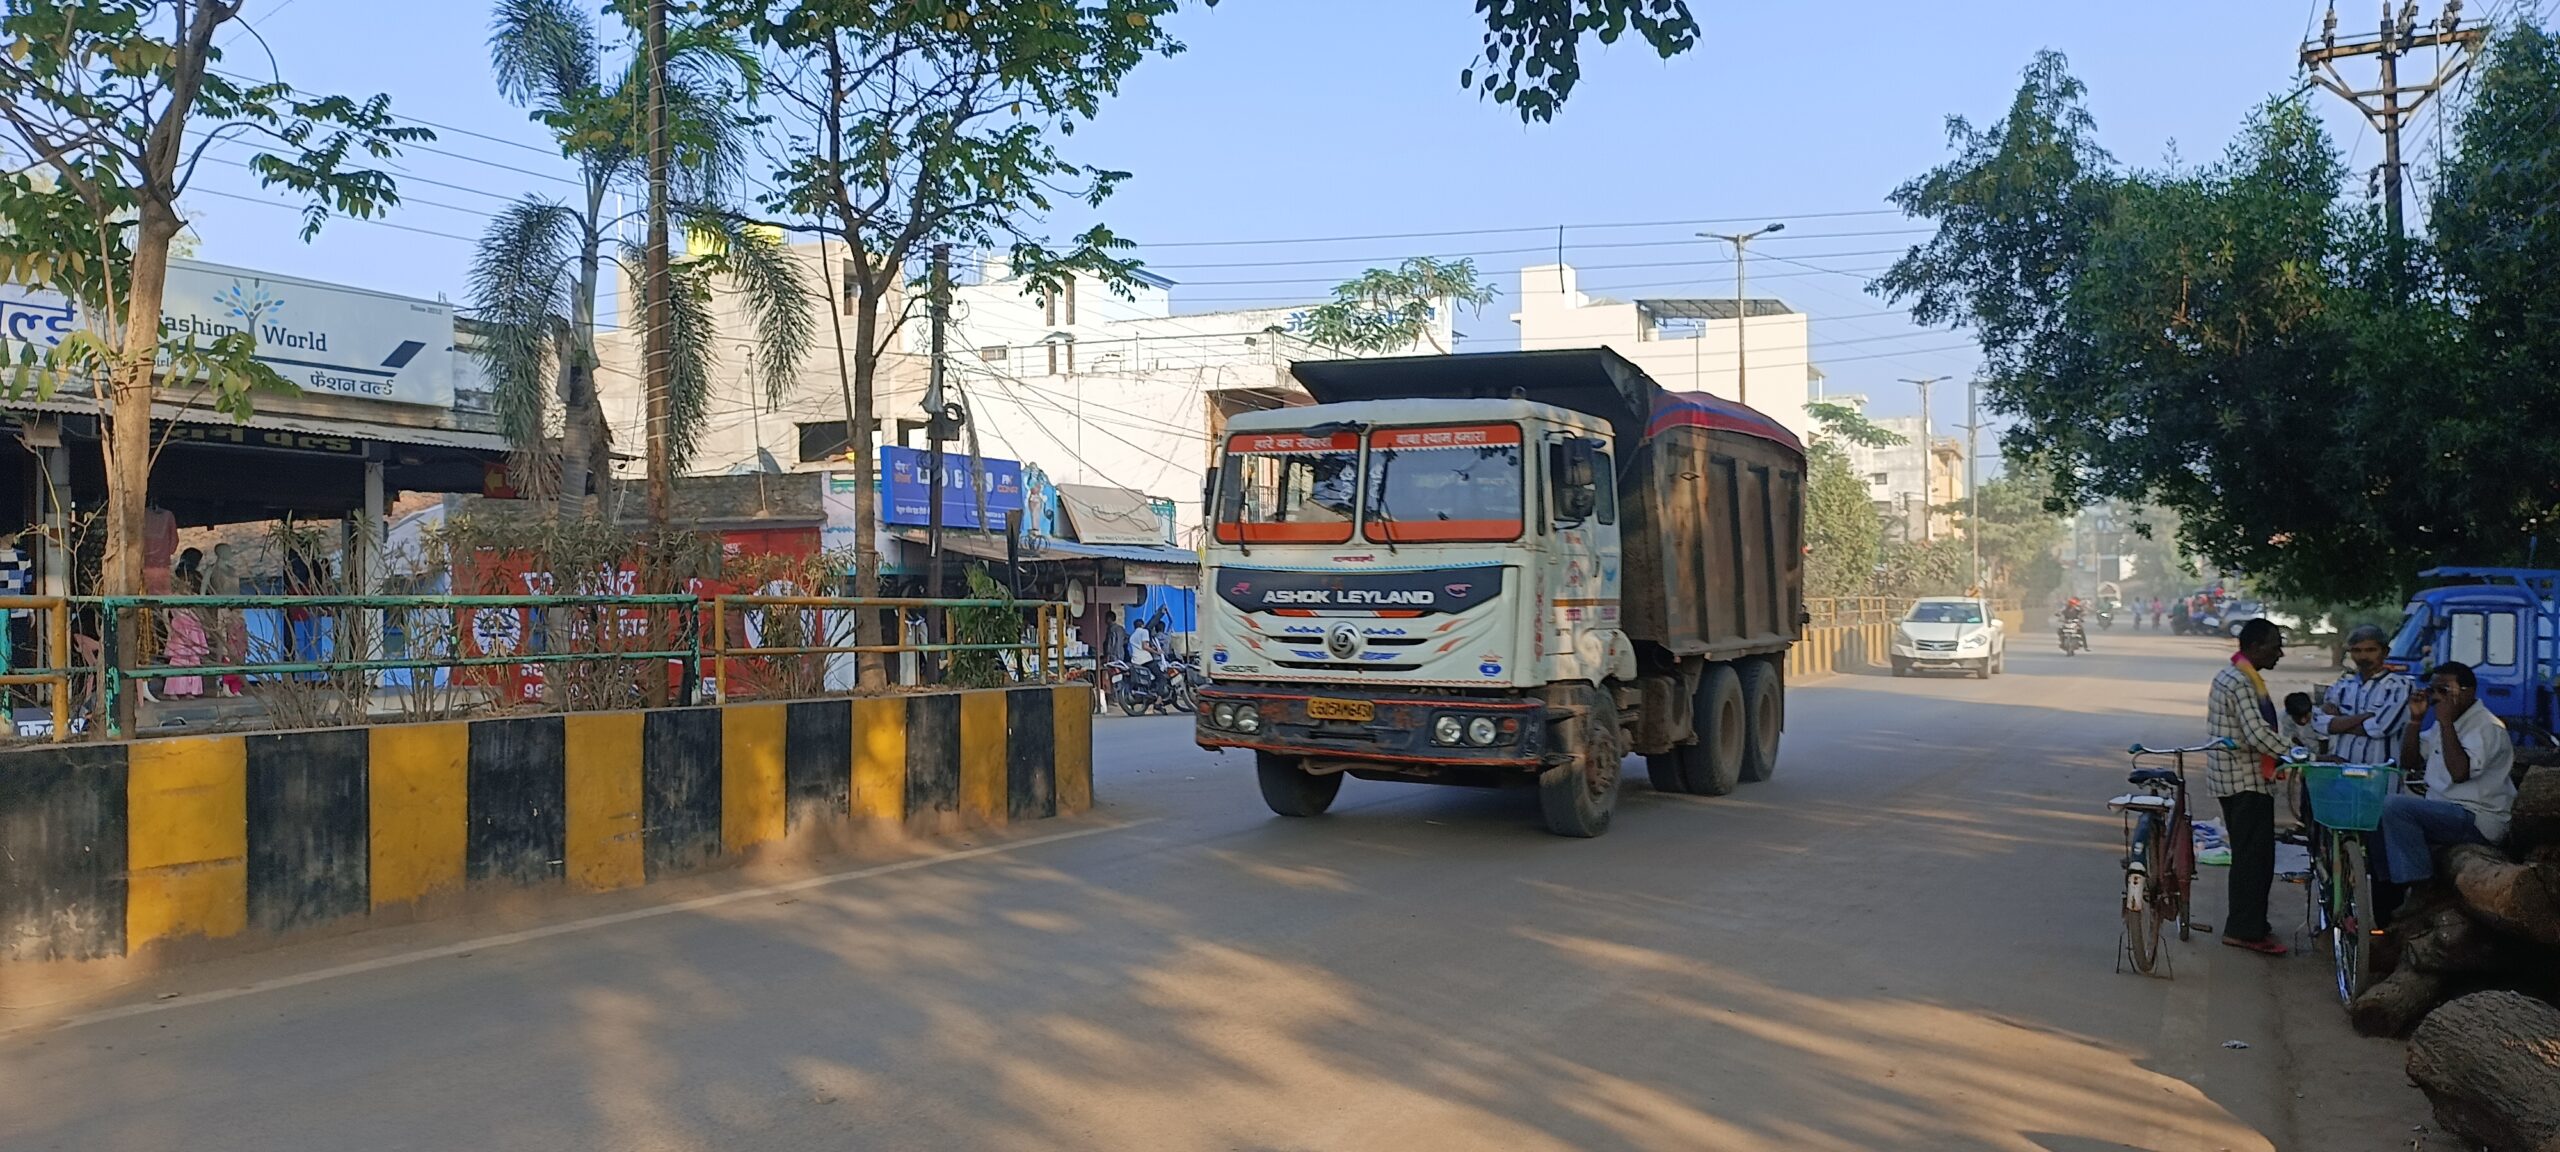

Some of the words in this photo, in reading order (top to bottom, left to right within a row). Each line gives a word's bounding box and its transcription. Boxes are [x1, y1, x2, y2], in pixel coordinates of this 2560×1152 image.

[160, 310, 238, 337] ashion
[262, 324, 328, 352] World
[310, 370, 356, 393] फैशन
[360, 379, 394, 396] वर्ल्ड
[1262, 589, 1330, 604] ASHOK
[1336, 590, 1435, 605] LEYLAND
